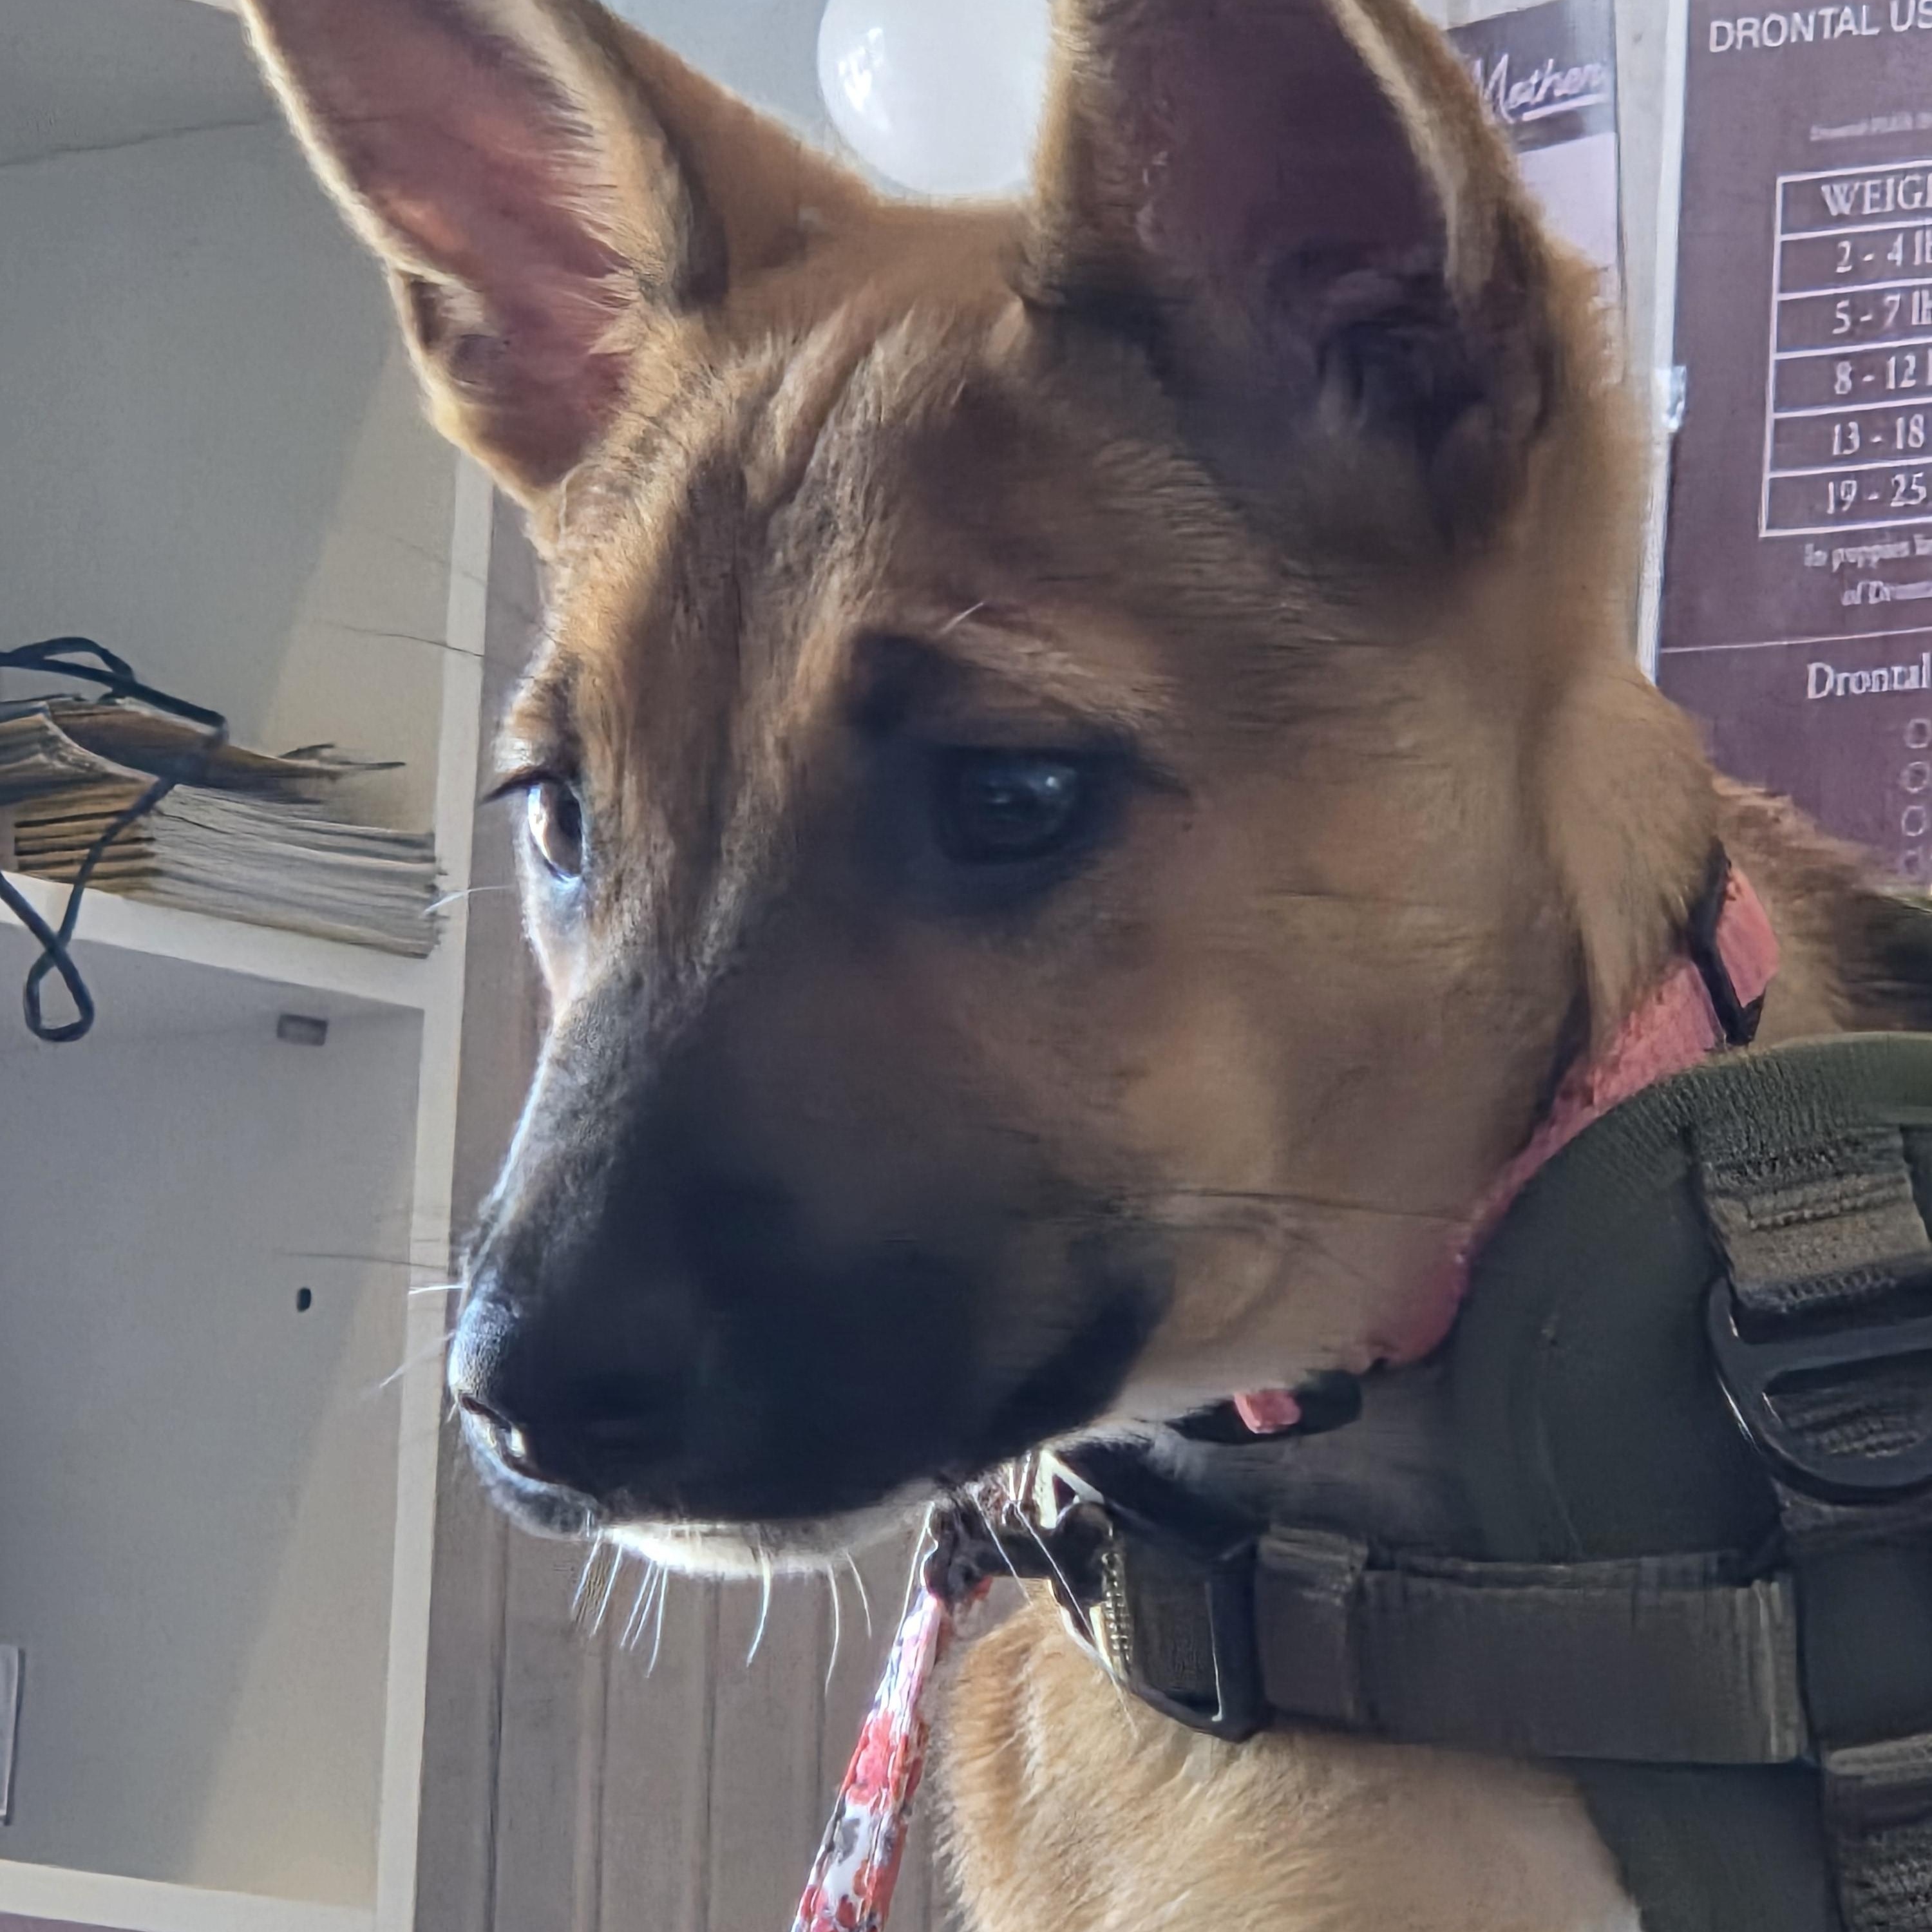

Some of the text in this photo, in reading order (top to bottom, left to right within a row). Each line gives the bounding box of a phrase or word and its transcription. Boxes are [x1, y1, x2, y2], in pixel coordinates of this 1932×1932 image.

[1709, 5, 1881, 53] DRONTAL
[1835, 240, 1853, 273] 2
[1887, 233, 1903, 267] 4
[1832, 299, 1851, 334] 5
[1884, 293, 1901, 328] 7
[1833, 361, 1852, 395] 8
[1886, 354, 1917, 390] 12
[1832, 421, 1860, 456] 13
[1895, 413, 1925, 450] 18
[1826, 480, 1857, 515] 19
[1890, 473, 1927, 507] 25
